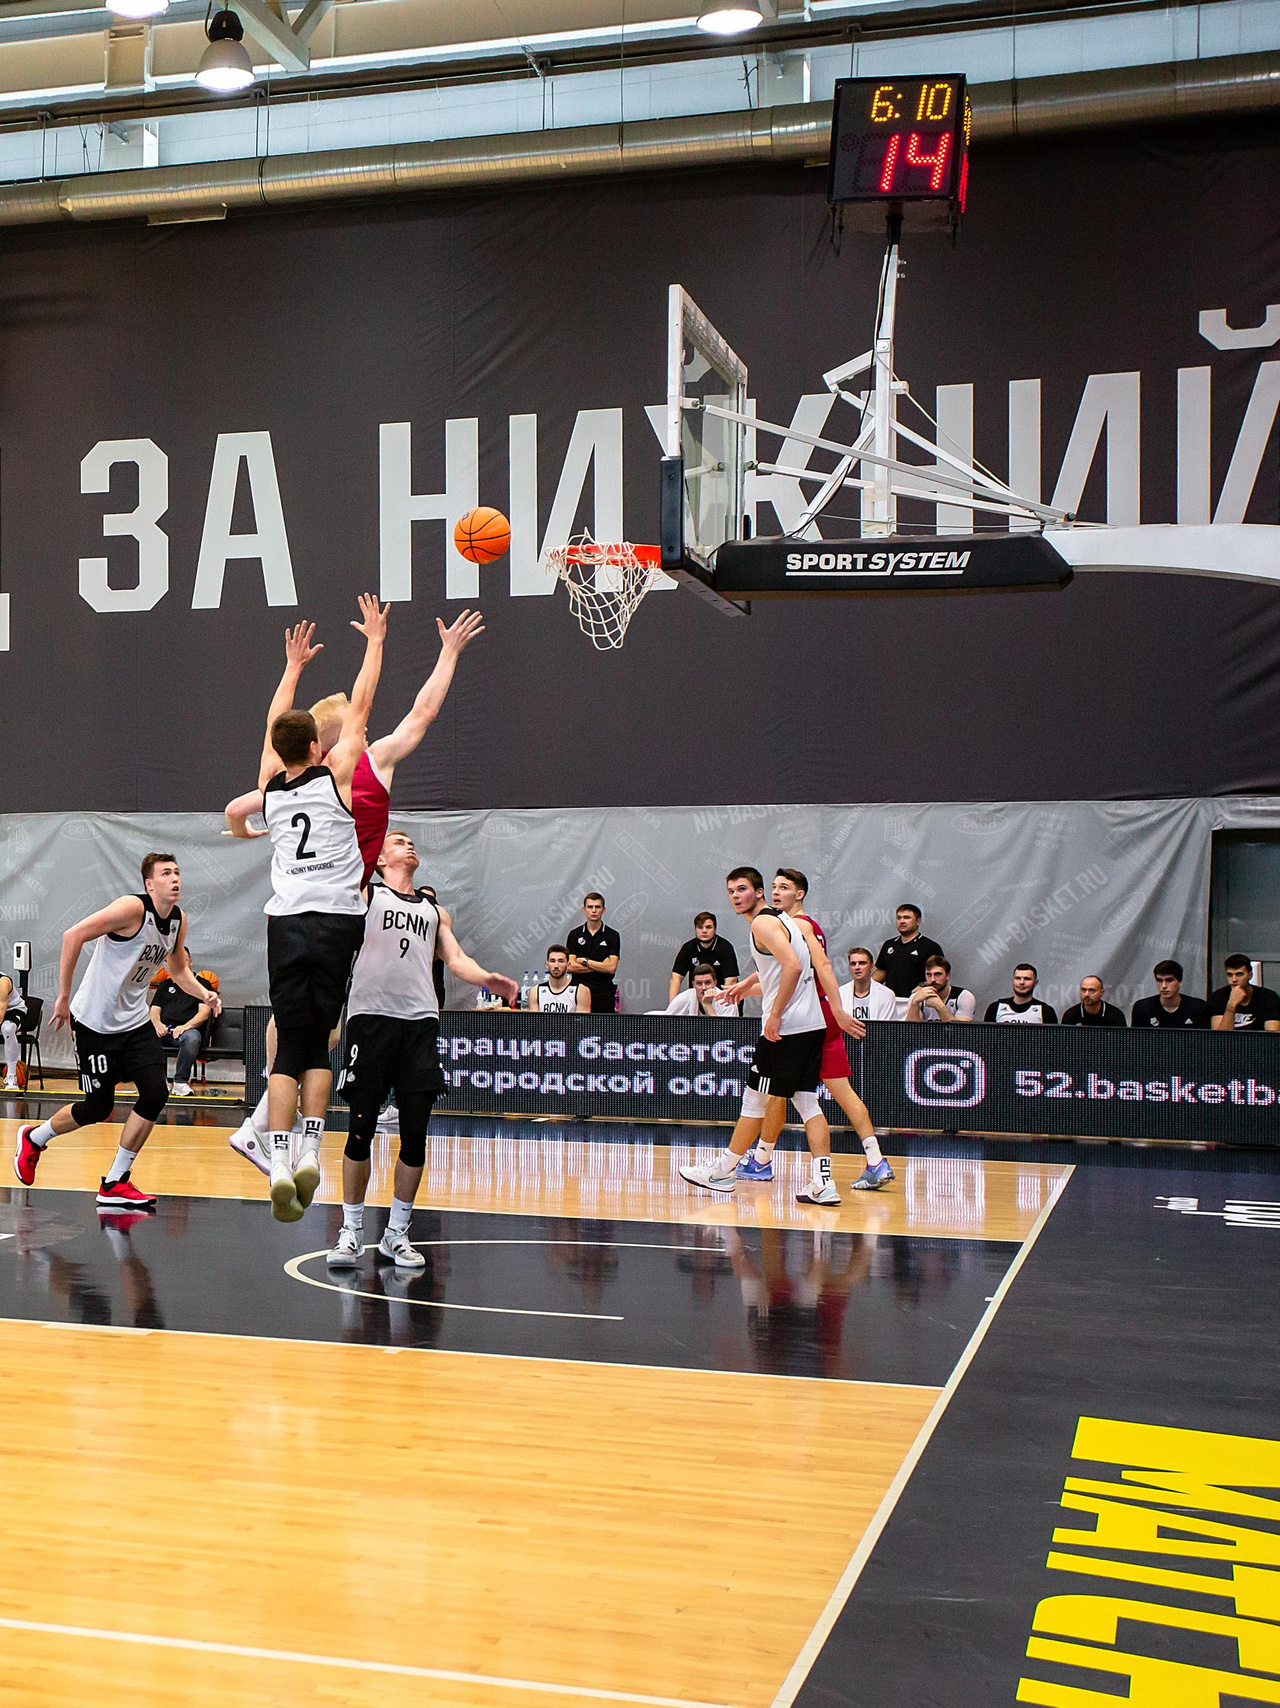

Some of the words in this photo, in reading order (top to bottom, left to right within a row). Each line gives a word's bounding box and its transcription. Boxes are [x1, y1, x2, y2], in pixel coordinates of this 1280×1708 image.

[871, 83, 952, 122] 6:10
[880, 132, 951, 192] 14
[79, 431, 299, 613] ЗА
[291, 812, 317, 860] 2
[383, 909, 430, 942] BCNN
[976, 863, 1109, 966] NN-BASKET.RU
[399, 937, 410, 958] 9
[131, 966, 150, 983] 10
[88, 1054, 108, 1074] 10
[349, 1043, 359, 1066] 9
[1014, 1069, 1280, 1106] 52.basketb
